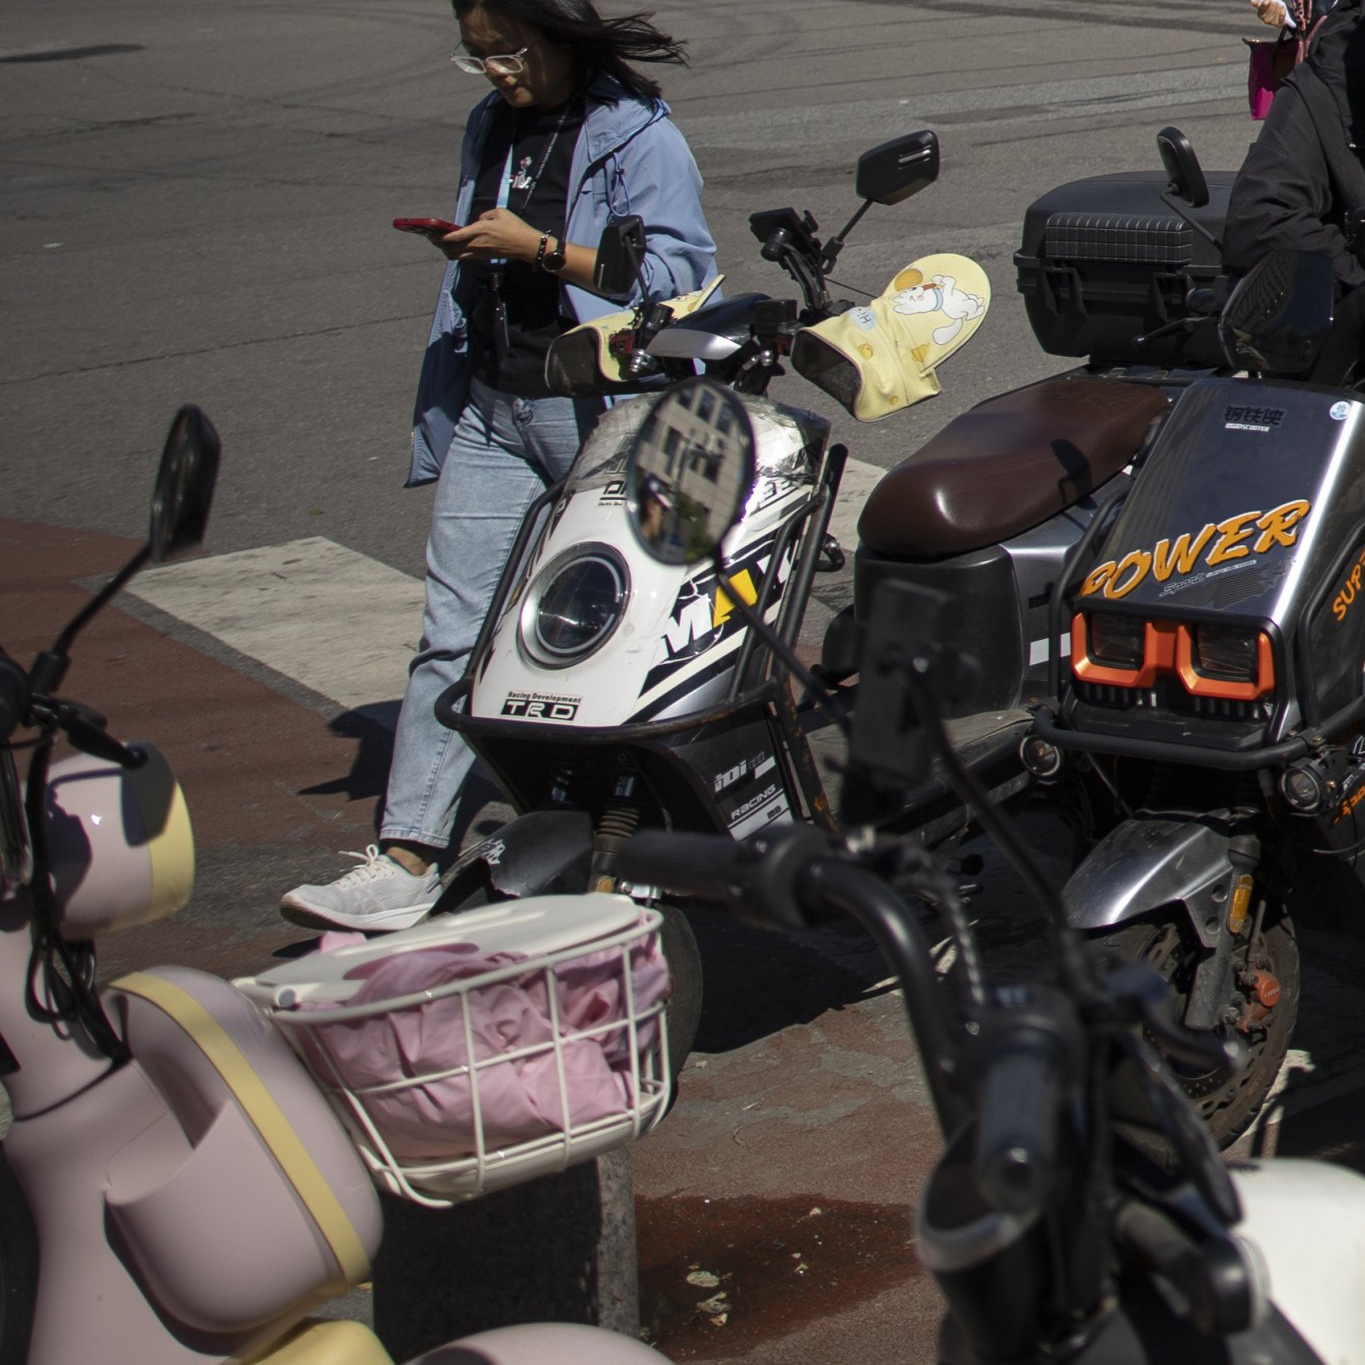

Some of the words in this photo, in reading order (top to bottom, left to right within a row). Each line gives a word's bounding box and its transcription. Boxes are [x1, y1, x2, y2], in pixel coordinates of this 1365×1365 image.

[1079, 499, 1311, 600] POWER
[506, 700, 576, 720] TRD
[508, 691, 531, 701] Racing
[532, 693, 582, 704] Development
[731, 783, 777, 820] RACING
